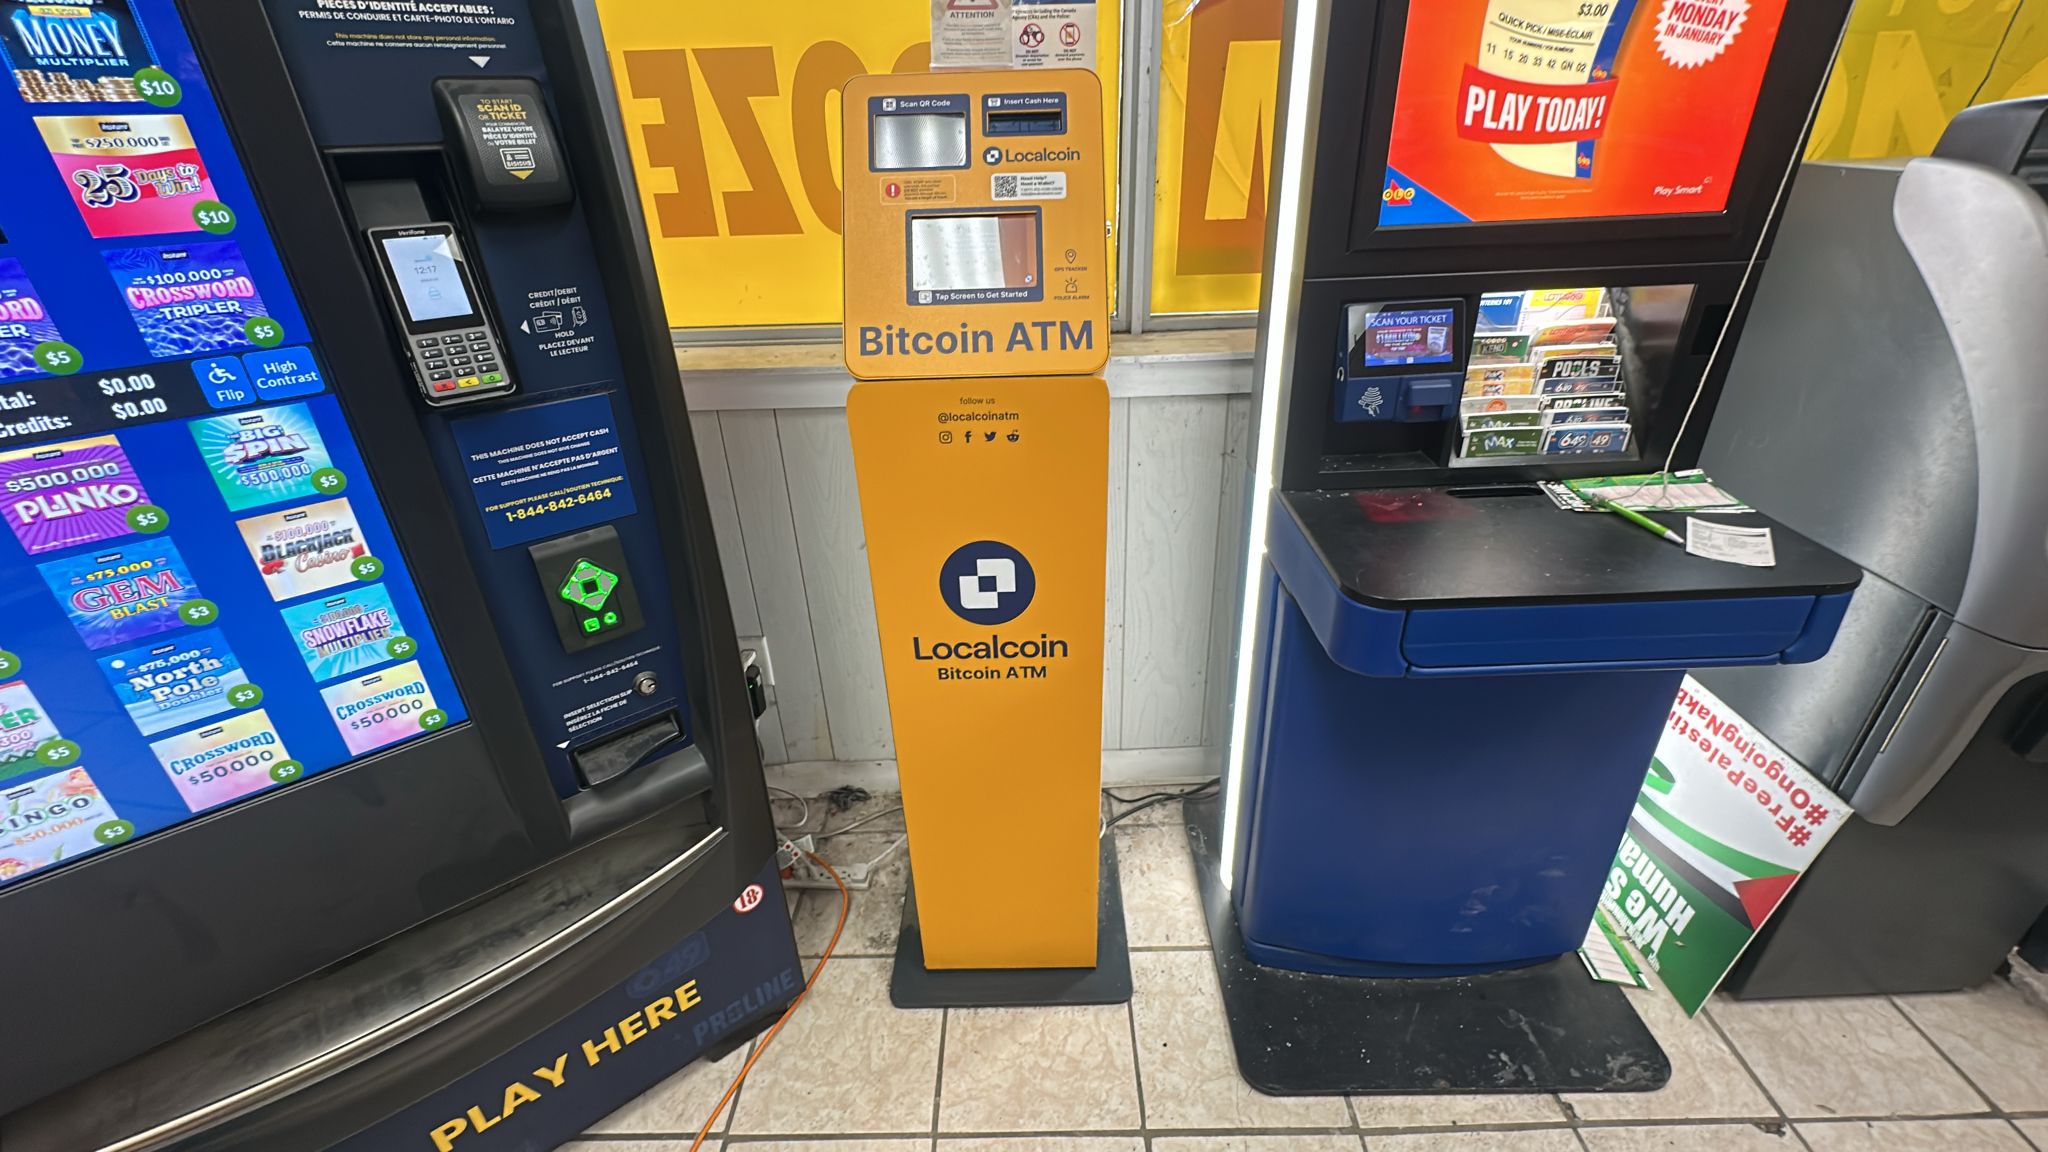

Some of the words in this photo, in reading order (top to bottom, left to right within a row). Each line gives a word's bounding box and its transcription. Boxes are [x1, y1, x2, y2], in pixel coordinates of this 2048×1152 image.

[299, 11, 332, 19] PERMIS
[333, 12, 345, 20] DE
[346, 12, 391, 21] CONDUIRE
[404, 15, 462, 23] CARTE-PHOTO
[476, 17, 515, 25] L'ONTARIO
[1578, 3, 1608, 17] $3.00
[1668, 1, 1740, 31] MONDAY
[1498, 12, 1523, 29] QUICK
[1526, 24, 1542, 34] PICK
[1548, 27, 1594, 40] MISE-ÉCLAIR
[1664, 23, 1678, 37] IN
[1676, 27, 1725, 46] JANUARY
[14, 20, 125, 57] MONEY
[36, 57, 129, 66] MULTIPLIER
[1487, 43, 1496, 55] 11
[1547, 60, 1556, 69] 42
[1576, 63, 1587, 73] 02
[140, 78, 175, 96] $10
[900, 100, 917, 108] Scan
[930, 99, 951, 107] Code
[1464, 84, 1529, 132] PLAY
[1535, 95, 1607, 133] TODAY!
[489, 112, 527, 120] TICKET
[1006, 148, 1081, 163] Localcoin
[134, 168, 176, 185] Days
[73, 165, 141, 207] 25
[154, 177, 201, 198] Win!
[1384, 188, 1415, 201] OLG
[1654, 186, 1674, 197] Play
[1674, 185, 1703, 195] Smart
[198, 211, 230, 226] $10
[414, 266, 437, 275] 12:17
[127, 276, 255, 310] CROSSWORD
[160, 300, 243, 322] TRIPLER
[1370, 318, 1394, 326] SCAN
[1396, 316, 1418, 325] YOUR
[1420, 314, 1447, 324] TICKET
[254, 326, 274, 339] $5
[555, 330, 575, 339] HOLD
[567, 336, 595, 347] DEVANT
[860, 322, 993, 356] Bitcoin
[1006, 320, 1093, 352] ATM
[46, 351, 71, 366] $5
[264, 361, 297, 375] High
[1553, 360, 1601, 378] POOLS
[98, 374, 156, 396] $0.00
[257, 370, 318, 390] Contrast
[217, 388, 245, 403] Flip
[960, 397, 984, 405] follow
[112, 398, 168, 420] $0.00
[938, 412, 1020, 424] @localcoinatm
[239, 425, 284, 442] BIG
[471, 453, 489, 461] THIS
[490, 445, 524, 458] MACHINE
[525, 441, 545, 450] DOES
[546, 438, 561, 446] NOT
[562, 432, 589, 443] ACCEPT
[590, 428, 609, 437] CASH
[241, 463, 312, 486] $500,000
[473, 474, 496, 484] CETTE
[497, 466, 532, 479] MACHINE
[532, 458, 571, 471] N'ACCEPTE
[571, 454, 585, 462] PAS
[586, 447, 619, 460] D'ARGENT
[5, 462, 121, 493] $500,000
[321, 476, 338, 488] $5
[14, 484, 139, 524] PLINKO
[499, 498, 527, 510] SUPPORT
[528, 493, 549, 502] PLEASE
[506, 488, 612, 522] 1-844-842-6464
[136, 513, 159, 527] $5
[261, 528, 354, 562] BLACKJACK
[295, 549, 350, 573] Casino
[359, 563, 376, 575] $5
[72, 569, 185, 613] GEM
[110, 595, 169, 620] BLAST
[188, 607, 210, 619] $3
[303, 609, 391, 648] SNOWFLAKE
[317, 628, 391, 658] MULTIPLIER
[394, 642, 410, 654] $5
[913, 634, 1068, 660] Localcoin
[130, 657, 223, 691] North
[938, 667, 1001, 680] Bitcoin
[1007, 666, 1047, 679] ATM
[151, 675, 219, 703] Pole
[235, 690, 255, 702] $3
[158, 688, 223, 711] Doubler
[336, 681, 425, 720] CROSSWORD
[586, 695, 620, 710] SELECTION
[426, 714, 441, 725] $3
[48, 747, 70, 760] $5
[170, 732, 275, 776] CROSSWORD
[278, 766, 296, 778] $3
[104, 826, 126, 839] $3
[430, 1053, 569, 1152] PLAY
[581, 979, 702, 1067] HERE
